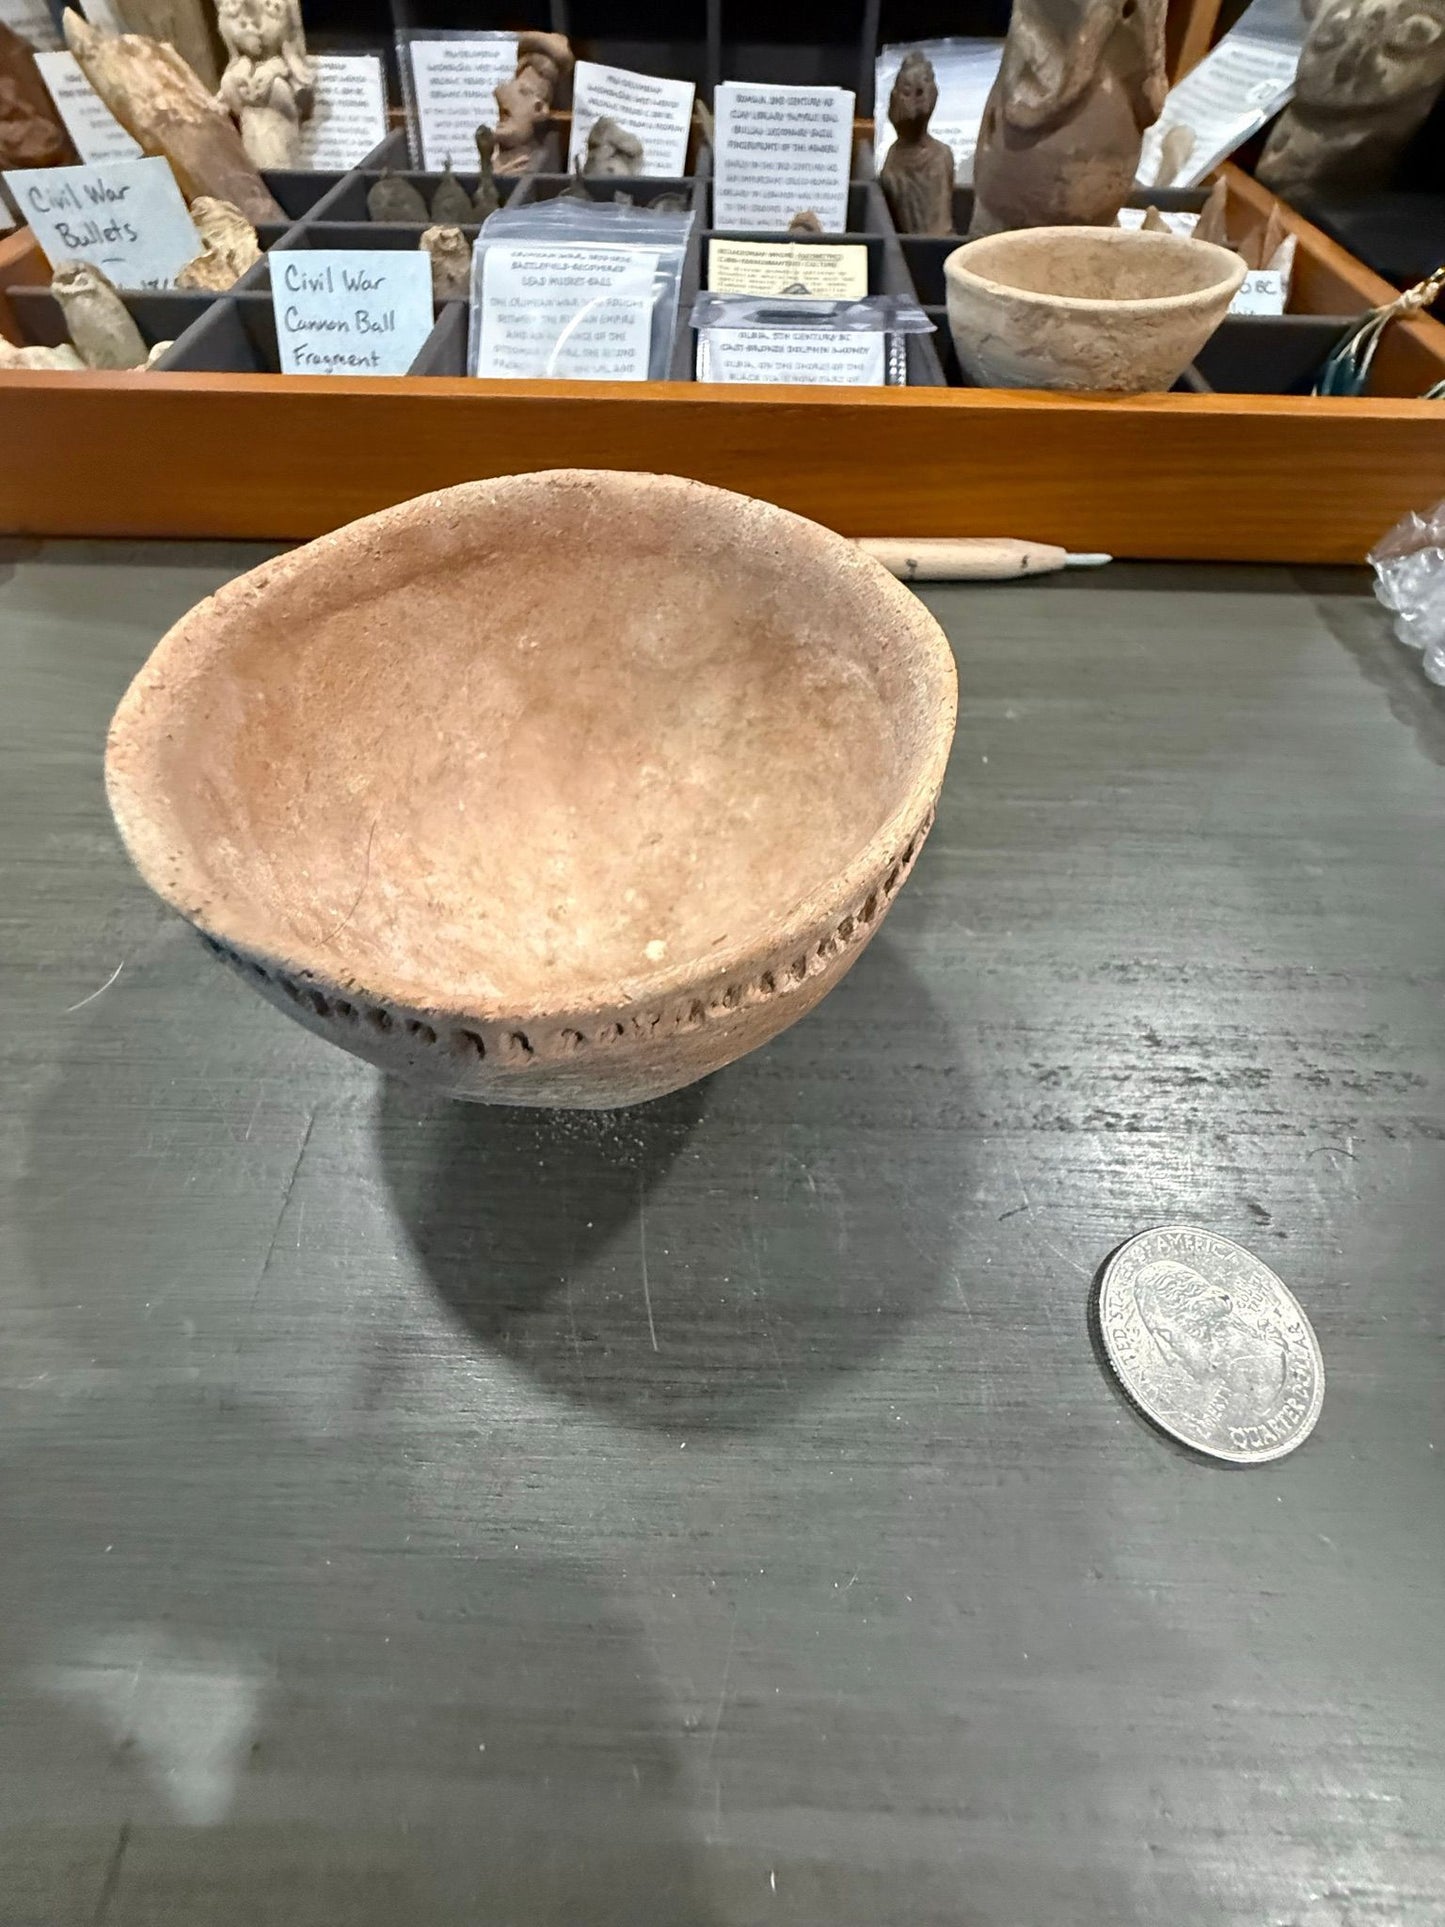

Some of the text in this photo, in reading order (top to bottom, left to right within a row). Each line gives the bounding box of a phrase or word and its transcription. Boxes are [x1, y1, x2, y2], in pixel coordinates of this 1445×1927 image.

[28, 178, 131, 213] Civil War
[54, 218, 138, 248] Bullets
[285, 264, 386, 293] Civil War
[284, 306, 396, 334] Cannon Ball
[292, 343, 381, 373] Fragment
[1227, 1397, 1306, 1450] QUARTER
